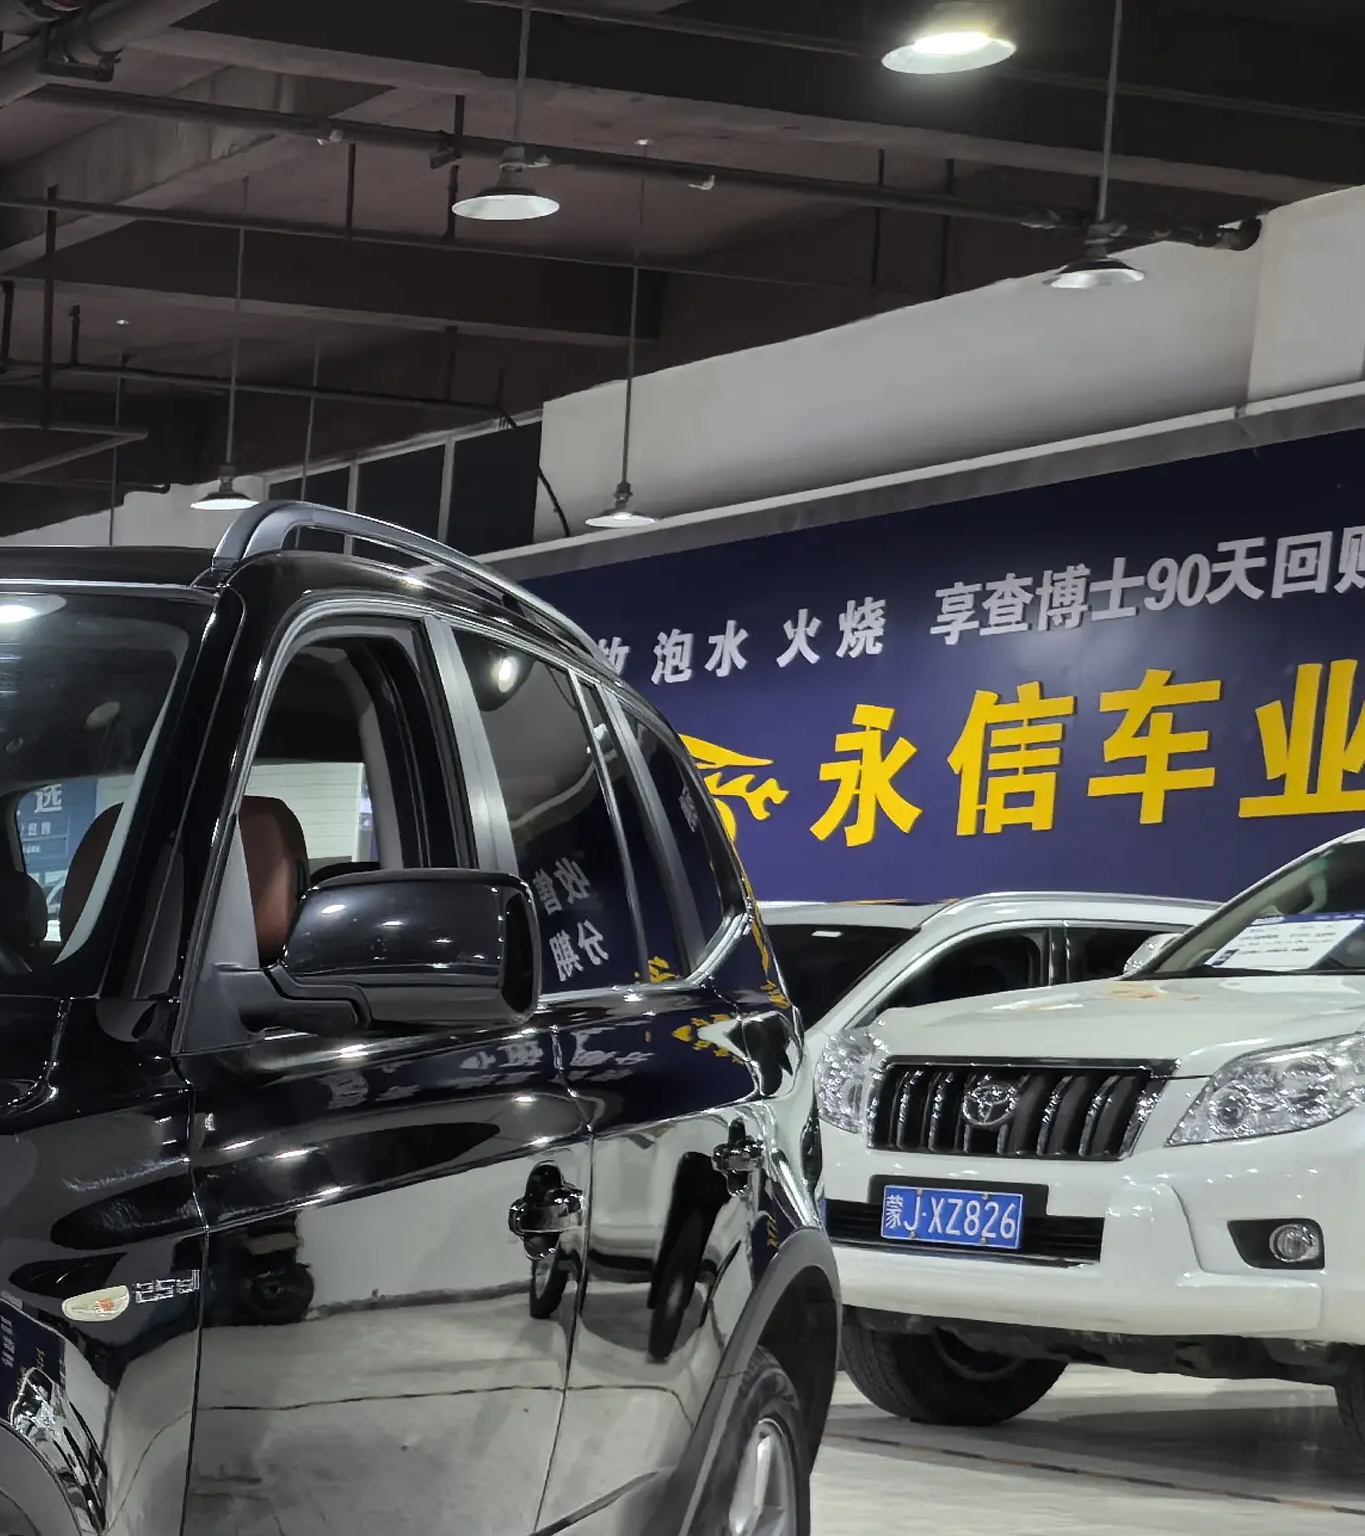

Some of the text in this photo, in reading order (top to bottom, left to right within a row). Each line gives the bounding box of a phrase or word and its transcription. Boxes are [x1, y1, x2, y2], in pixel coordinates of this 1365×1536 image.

[651, 620, 749, 685] 泡水
[776, 597, 887, 668] 火烧
[810, 659, 1365, 847] 永信车业
[884, 1193, 1017, 1240] 蒙J·XZ826
